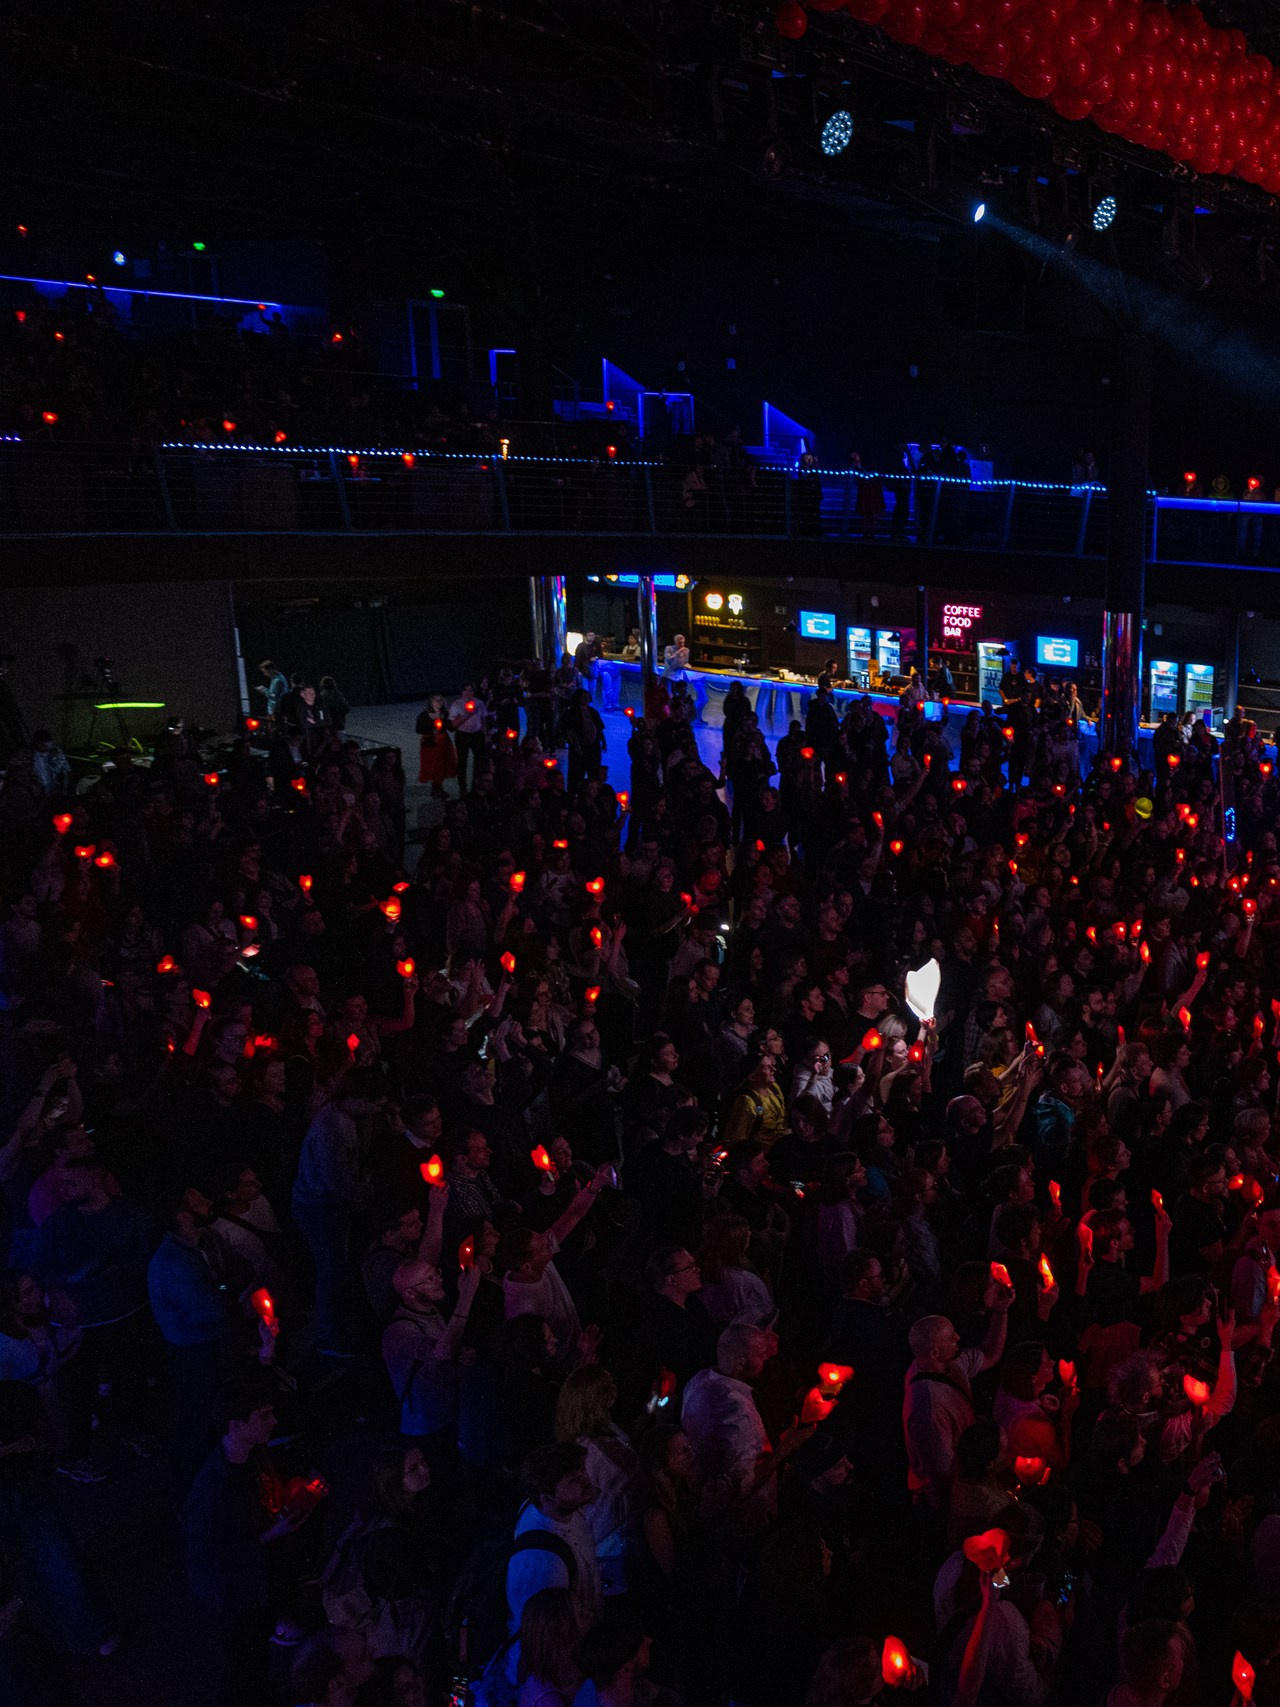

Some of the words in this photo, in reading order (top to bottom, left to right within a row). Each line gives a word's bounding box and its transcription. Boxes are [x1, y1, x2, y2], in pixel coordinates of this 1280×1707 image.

[944, 605, 981, 618] COFFEE
[944, 616, 972, 628] FOOD
[944, 626, 962, 637] BAR
